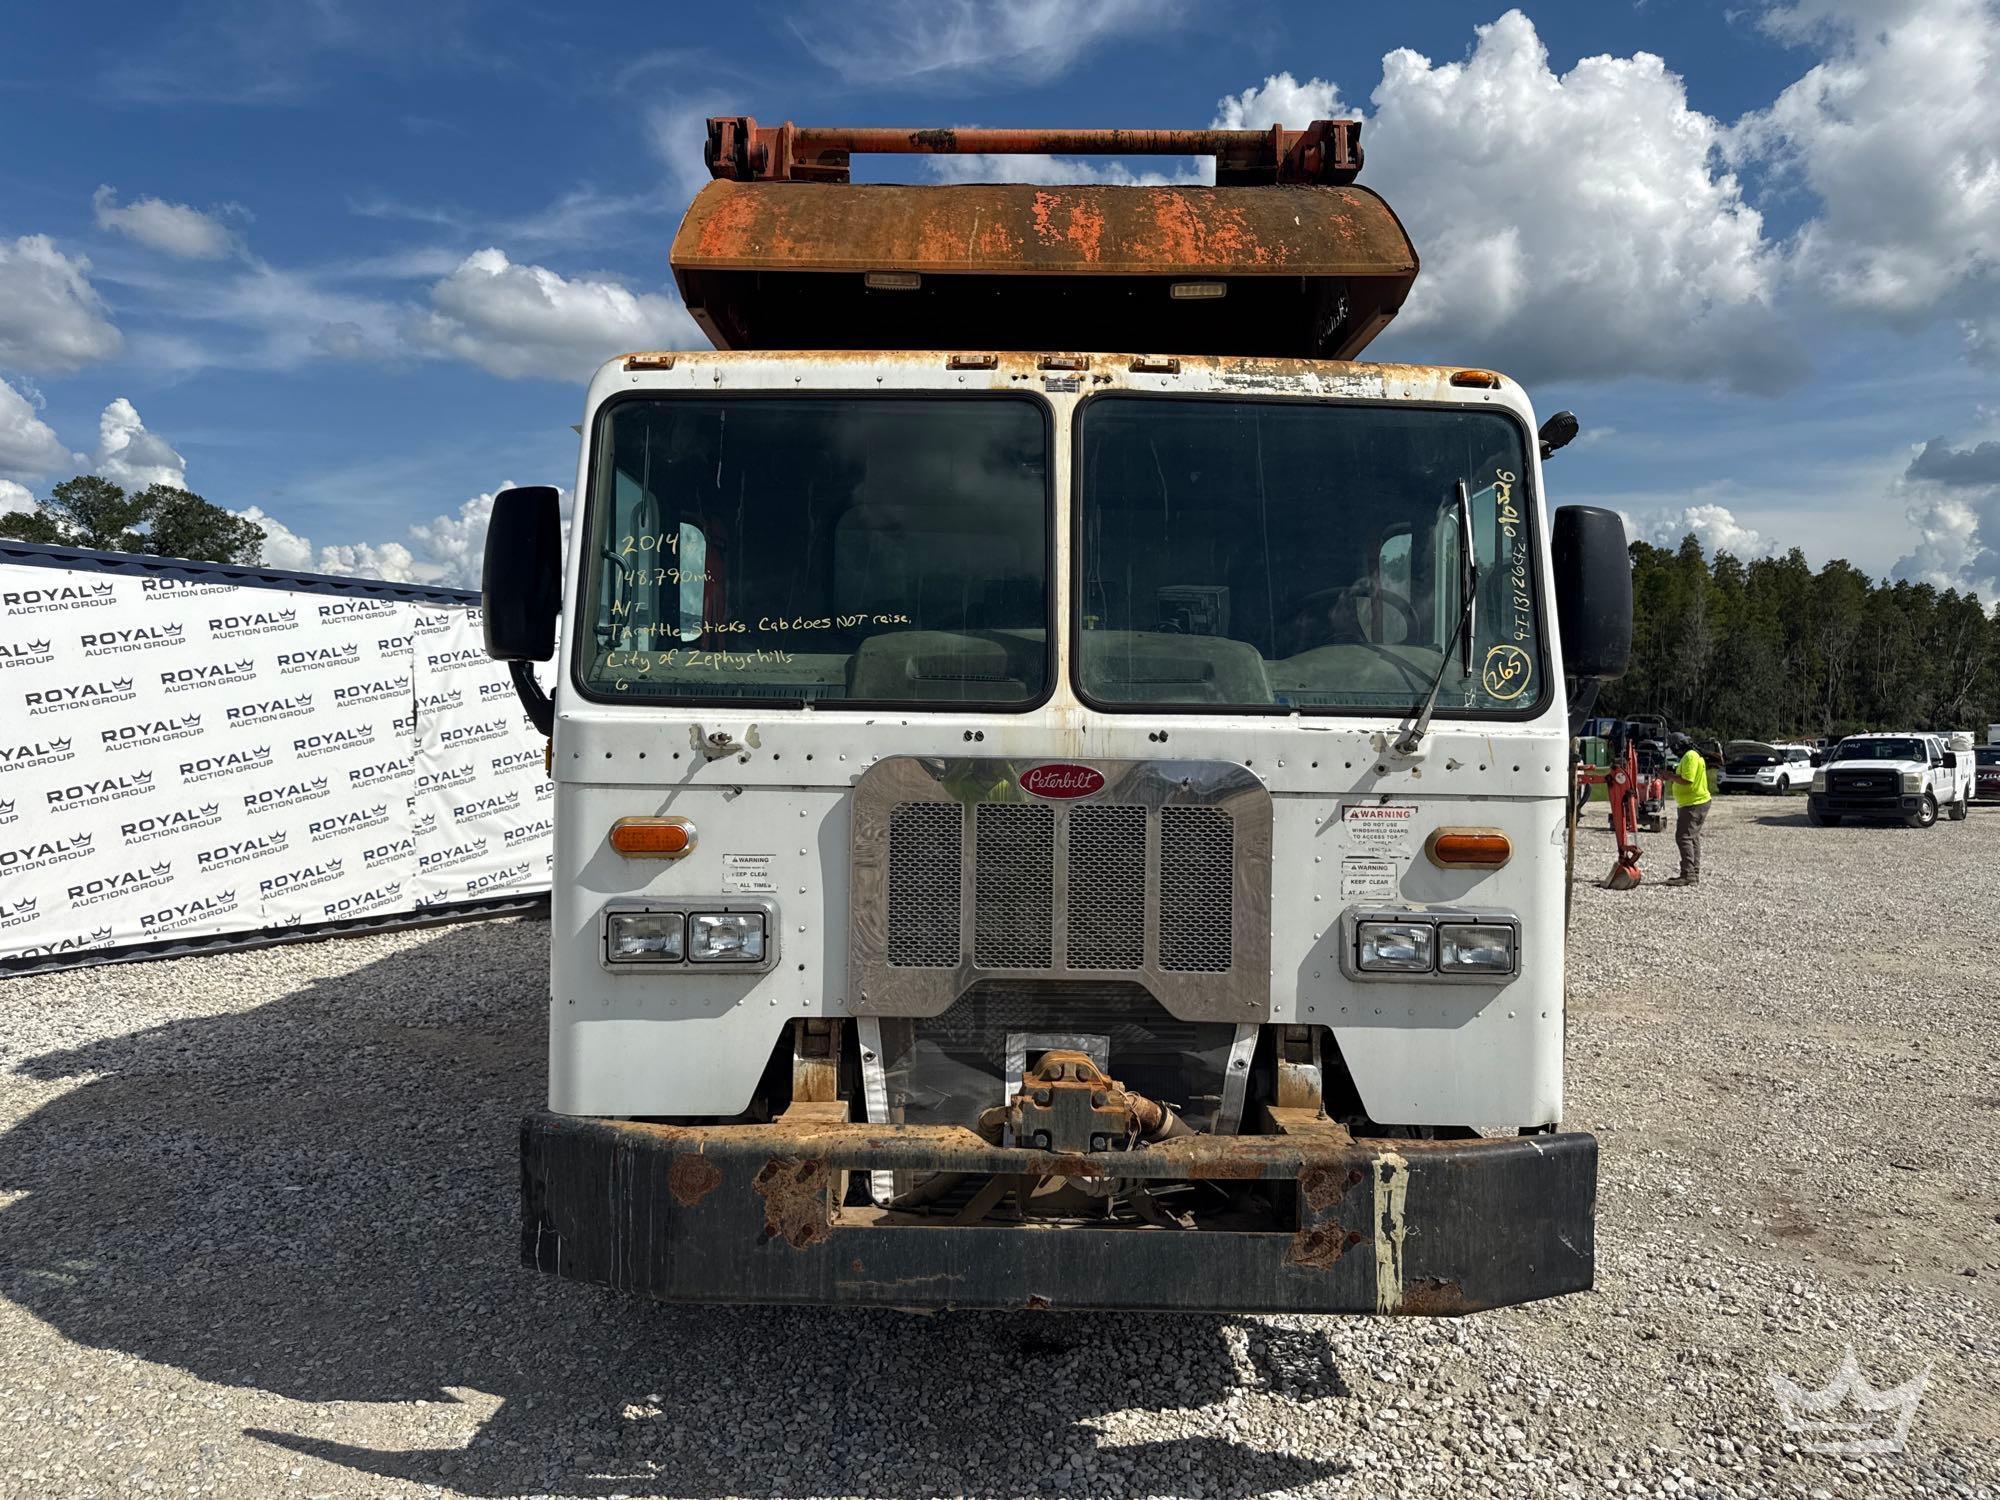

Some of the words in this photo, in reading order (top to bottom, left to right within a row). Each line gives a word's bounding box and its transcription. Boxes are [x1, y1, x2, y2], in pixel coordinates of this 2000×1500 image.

[622, 533, 679, 555] 2014
[142, 579, 205, 591] ROY
[146, 590, 198, 601] AUCTION
[201, 585, 239, 594] GROUP
[3, 586, 92, 606] ROYAL
[8, 603, 69, 616] AUCTION
[71, 598, 117, 609] GROUP
[318, 601, 380, 617] ROYAL
[322, 614, 364, 625] AUCTION
[365, 610, 397, 619] GROUP
[611, 600, 646, 616] A/T
[209, 613, 279, 631] ROYAL
[212, 628, 261, 640] AUCTION
[262, 623, 299, 633] GROUP
[421, 626, 450, 636] GROUP
[836, 614, 868, 629] NOT
[80, 627, 163, 648] ROYAL
[85, 644, 142, 657] AUCTION
[144, 638, 186, 650] GROUP
[378, 635, 414, 650] ROY
[5, 655, 55, 668] GROUP
[277, 648, 342, 667] ROYAL
[381, 648, 414, 658] AUCTIO
[427, 649, 480, 666] ROYAL
[606, 652, 651, 673] City
[658, 648, 679, 664] of
[685, 649, 796, 672] Zephyrhills
[161, 664, 236, 685] ROYAL
[280, 662, 325, 674] AUCTION
[326, 656, 360, 667] GROUP
[431, 662, 467, 673] AUCTION
[1486, 651, 1521, 690] 265
[165, 680, 216, 694] AUCTION
[218, 673, 256, 685] GROUP
[334, 681, 395, 700] ROYAL
[479, 681, 516, 695] ROY
[25, 683, 113, 706] ROYAL
[30, 700, 90, 716] AUCTION
[92, 692, 136, 706] GROUP
[337, 695, 378, 708] AUCTION
[380, 689, 411, 699] GROUP
[226, 698, 296, 720] ROYAL
[230, 714, 277, 728] AUCTION
[279, 707, 315, 719] GROUP
[437, 702, 463, 712] GROUP
[101, 719, 182, 743] ROYAL
[105, 736, 161, 752] AUCTION
[163, 728, 204, 741] GROUP
[294, 730, 357, 751] ROYAL
[440, 723, 494, 743] ROYAL
[444, 737, 479, 750] AUCTION
[480, 731, 509, 741] GROUP
[0, 743, 50, 761] YAL
[27, 752, 75, 767] GROUP
[297, 745, 340, 760] AUCTION
[342, 738, 375, 749] GROUP
[492, 750, 541, 768] ROYAL
[179, 752, 253, 776] ROYAL
[183, 768, 234, 784] AUCTION
[236, 760, 273, 773] GROUP
[349, 759, 409, 782] ROYAL
[494, 763, 528, 776] AUCTION
[352, 774, 393, 789] AUCTION
[394, 769, 415, 779] GRO
[415, 770, 461, 788] OYAL
[415, 784, 447, 796] UCTION
[448, 776, 476, 788] GROUP
[1029, 769, 1098, 789] Peterbilt
[46, 777, 132, 804] ROYAL
[51, 795, 109, 814] AUCTION
[112, 785, 155, 800] GROUP
[244, 783, 312, 806] ROYAL
[247, 799, 293, 816] AUCTION
[295, 790, 330, 804] GROUP
[453, 796, 506, 818] ROYAL
[456, 810, 492, 824] AUCTION
[493, 802, 520, 814] GROUP
[121, 810, 201, 837] ROYAL
[309, 810, 372, 835] ROYAL
[1360, 810, 1410, 818] WARNING
[125, 827, 180, 846] AUCTION
[181, 816, 222, 832] GROUP
[312, 826, 355, 842] AUCTION
[356, 816, 389, 830] GROUP
[415, 826, 437, 836] ROUP
[504, 820, 552, 841] ROYAL
[197, 837, 270, 864] ROYAL
[506, 833, 539, 848] AUCTION
[0, 841, 70, 866] OYAL
[0, 859, 46, 877] CTION
[48, 848, 96, 864] GROUP
[201, 854, 250, 873] AUCTION
[252, 844, 289, 859] GROUP
[366, 852, 406, 869] AUCTION
[419, 844, 473, 867] ROYAL
[421, 858, 459, 875] AUCTION
[460, 849, 488, 863] GROUP
[67, 869, 151, 900] ROYAL
[259, 865, 326, 895] ROYAL
[260, 882, 309, 902] AUCTION
[310, 871, 345, 886] GROUP
[467, 868, 517, 891] ROYAL
[72, 887, 129, 909] AUCTION
[131, 875, 174, 892] GROUP
[324, 890, 386, 915] ROYAL
[371, 894, 403, 909] GROUP
[1, 912, 40, 928] ROUP
[140, 898, 218, 928] ROYAL
[144, 916, 197, 936] AUCTION
[199, 903, 238, 920] GROUP
